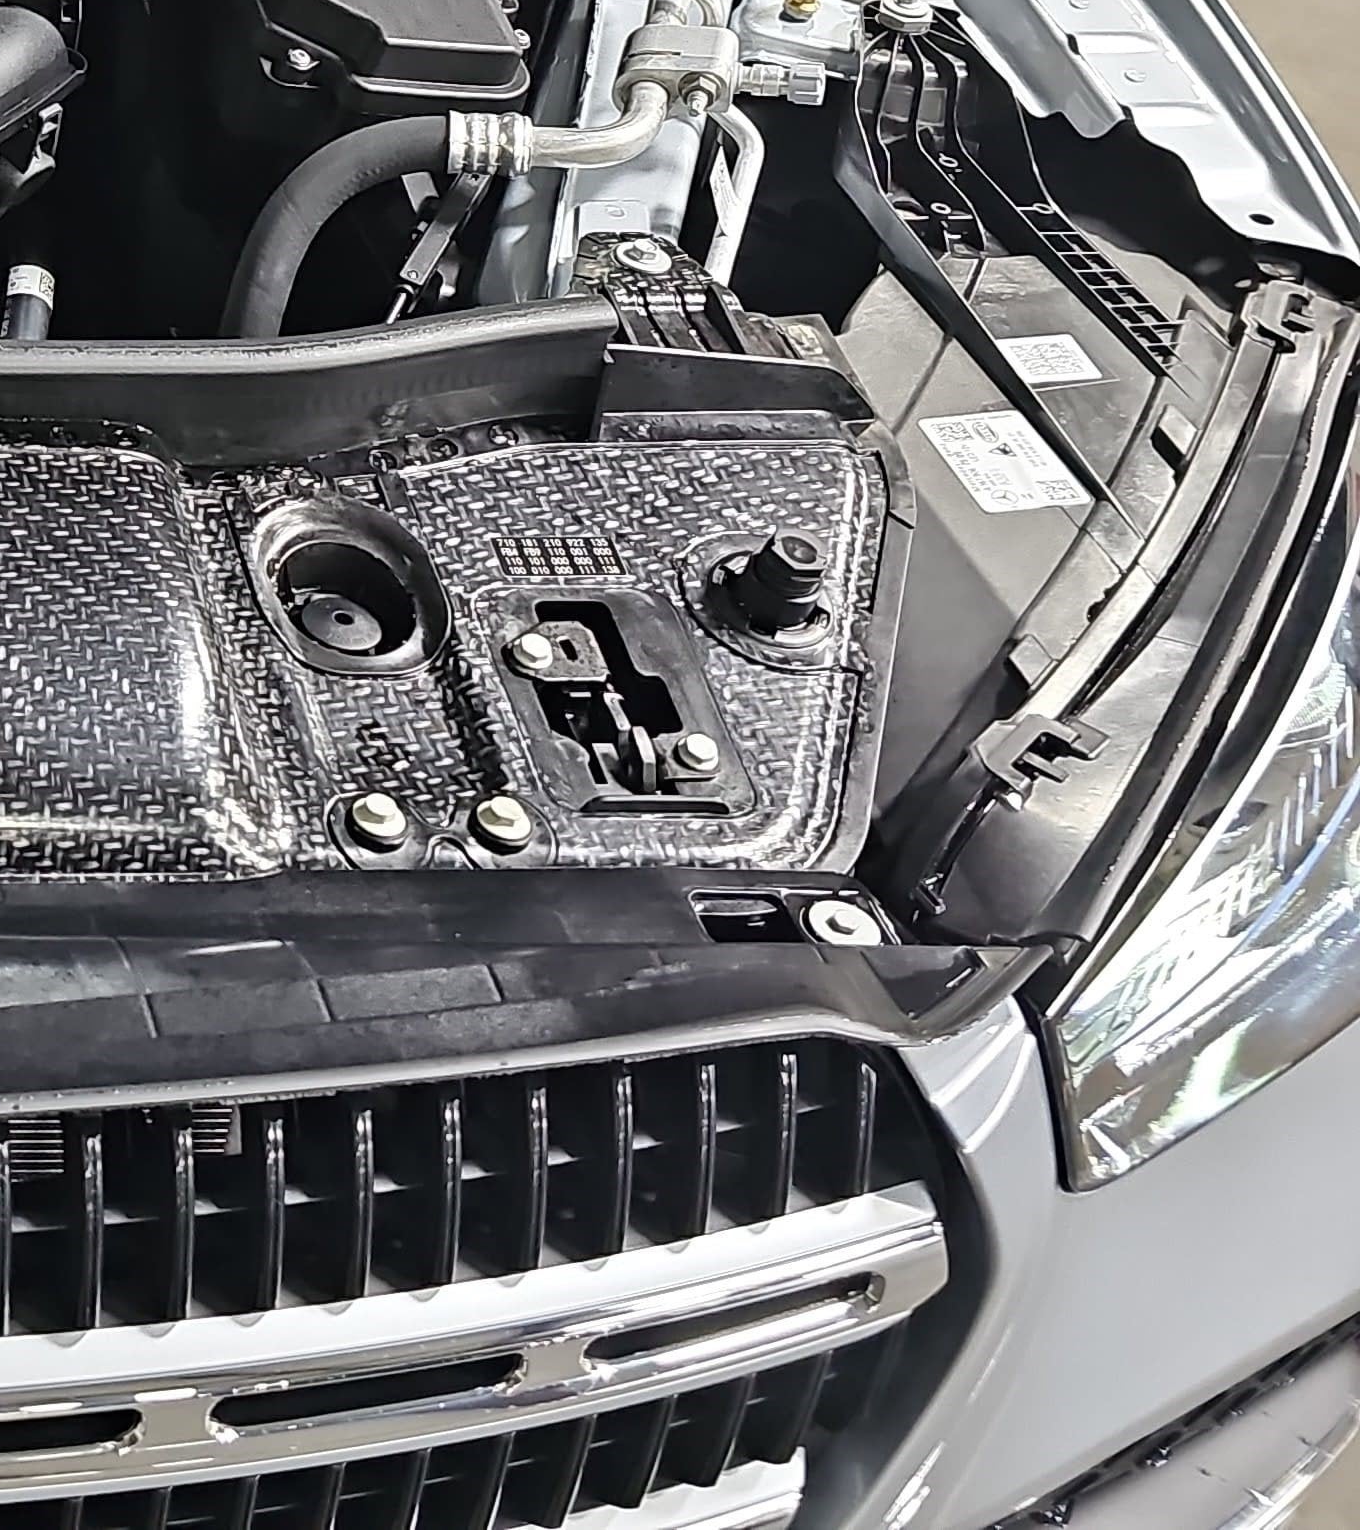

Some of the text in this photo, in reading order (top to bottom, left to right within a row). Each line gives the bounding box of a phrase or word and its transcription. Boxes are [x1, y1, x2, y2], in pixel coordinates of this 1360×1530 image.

[496, 538, 515, 547] 710
[543, 538, 561, 547] 210
[548, 548, 566, 557] 110
[570, 548, 588, 557] 001
[594, 548, 612, 557] 000
[506, 557, 616, 565] 110 101 000 000 111
[509, 566, 526, 575] 100
[532, 566, 550, 575] 010
[555, 566, 573, 575] 000
[580, 566, 596, 575] 111
